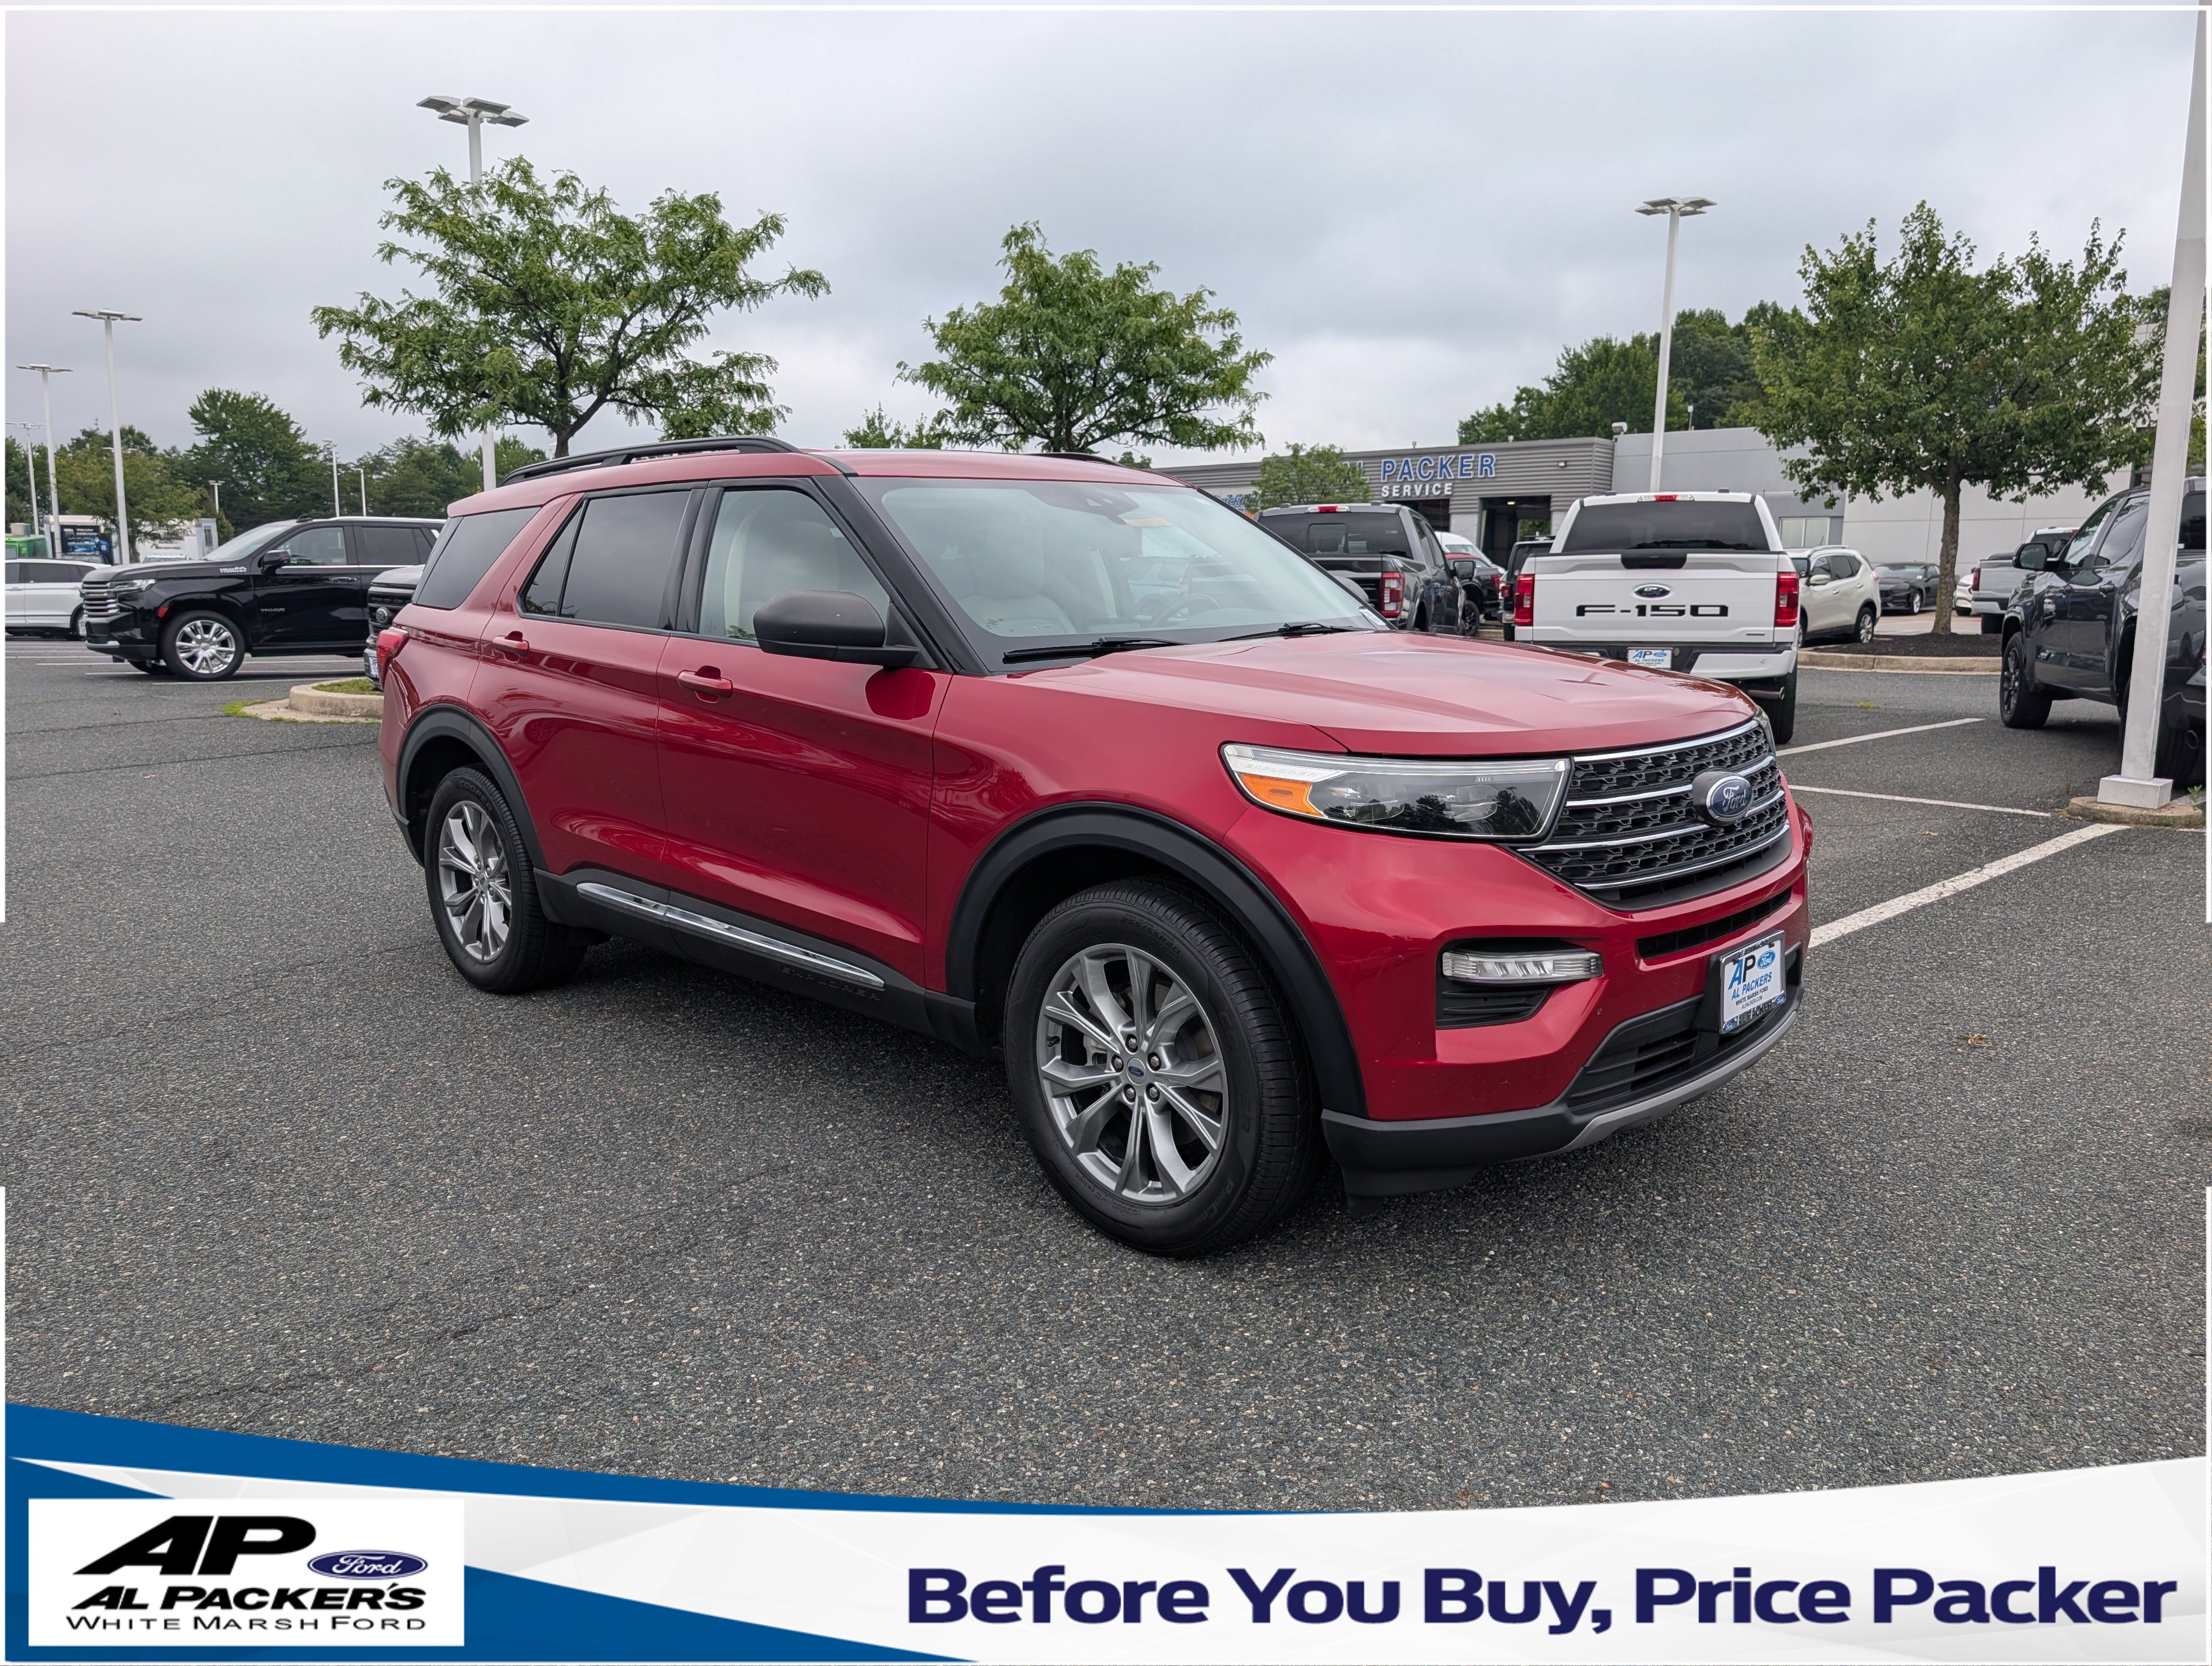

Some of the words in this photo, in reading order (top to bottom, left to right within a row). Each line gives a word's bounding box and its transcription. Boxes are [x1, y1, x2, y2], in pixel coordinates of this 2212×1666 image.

[1381, 453, 1496, 483] PACKER
[1382, 483, 1453, 497] SERVICE
[1576, 605, 1728, 617] F-150
[1245, 764, 1317, 777] EXPLORER
[459, 780, 492, 811] COOPER
[1722, 785, 1748, 812] Ford
[1759, 952, 1774, 968] Ford
[1728, 954, 1756, 990] AP
[1731, 986, 1740, 1001] AL
[1742, 971, 1772, 996] PACKERS
[1735, 996, 1747, 1006] WHITE
